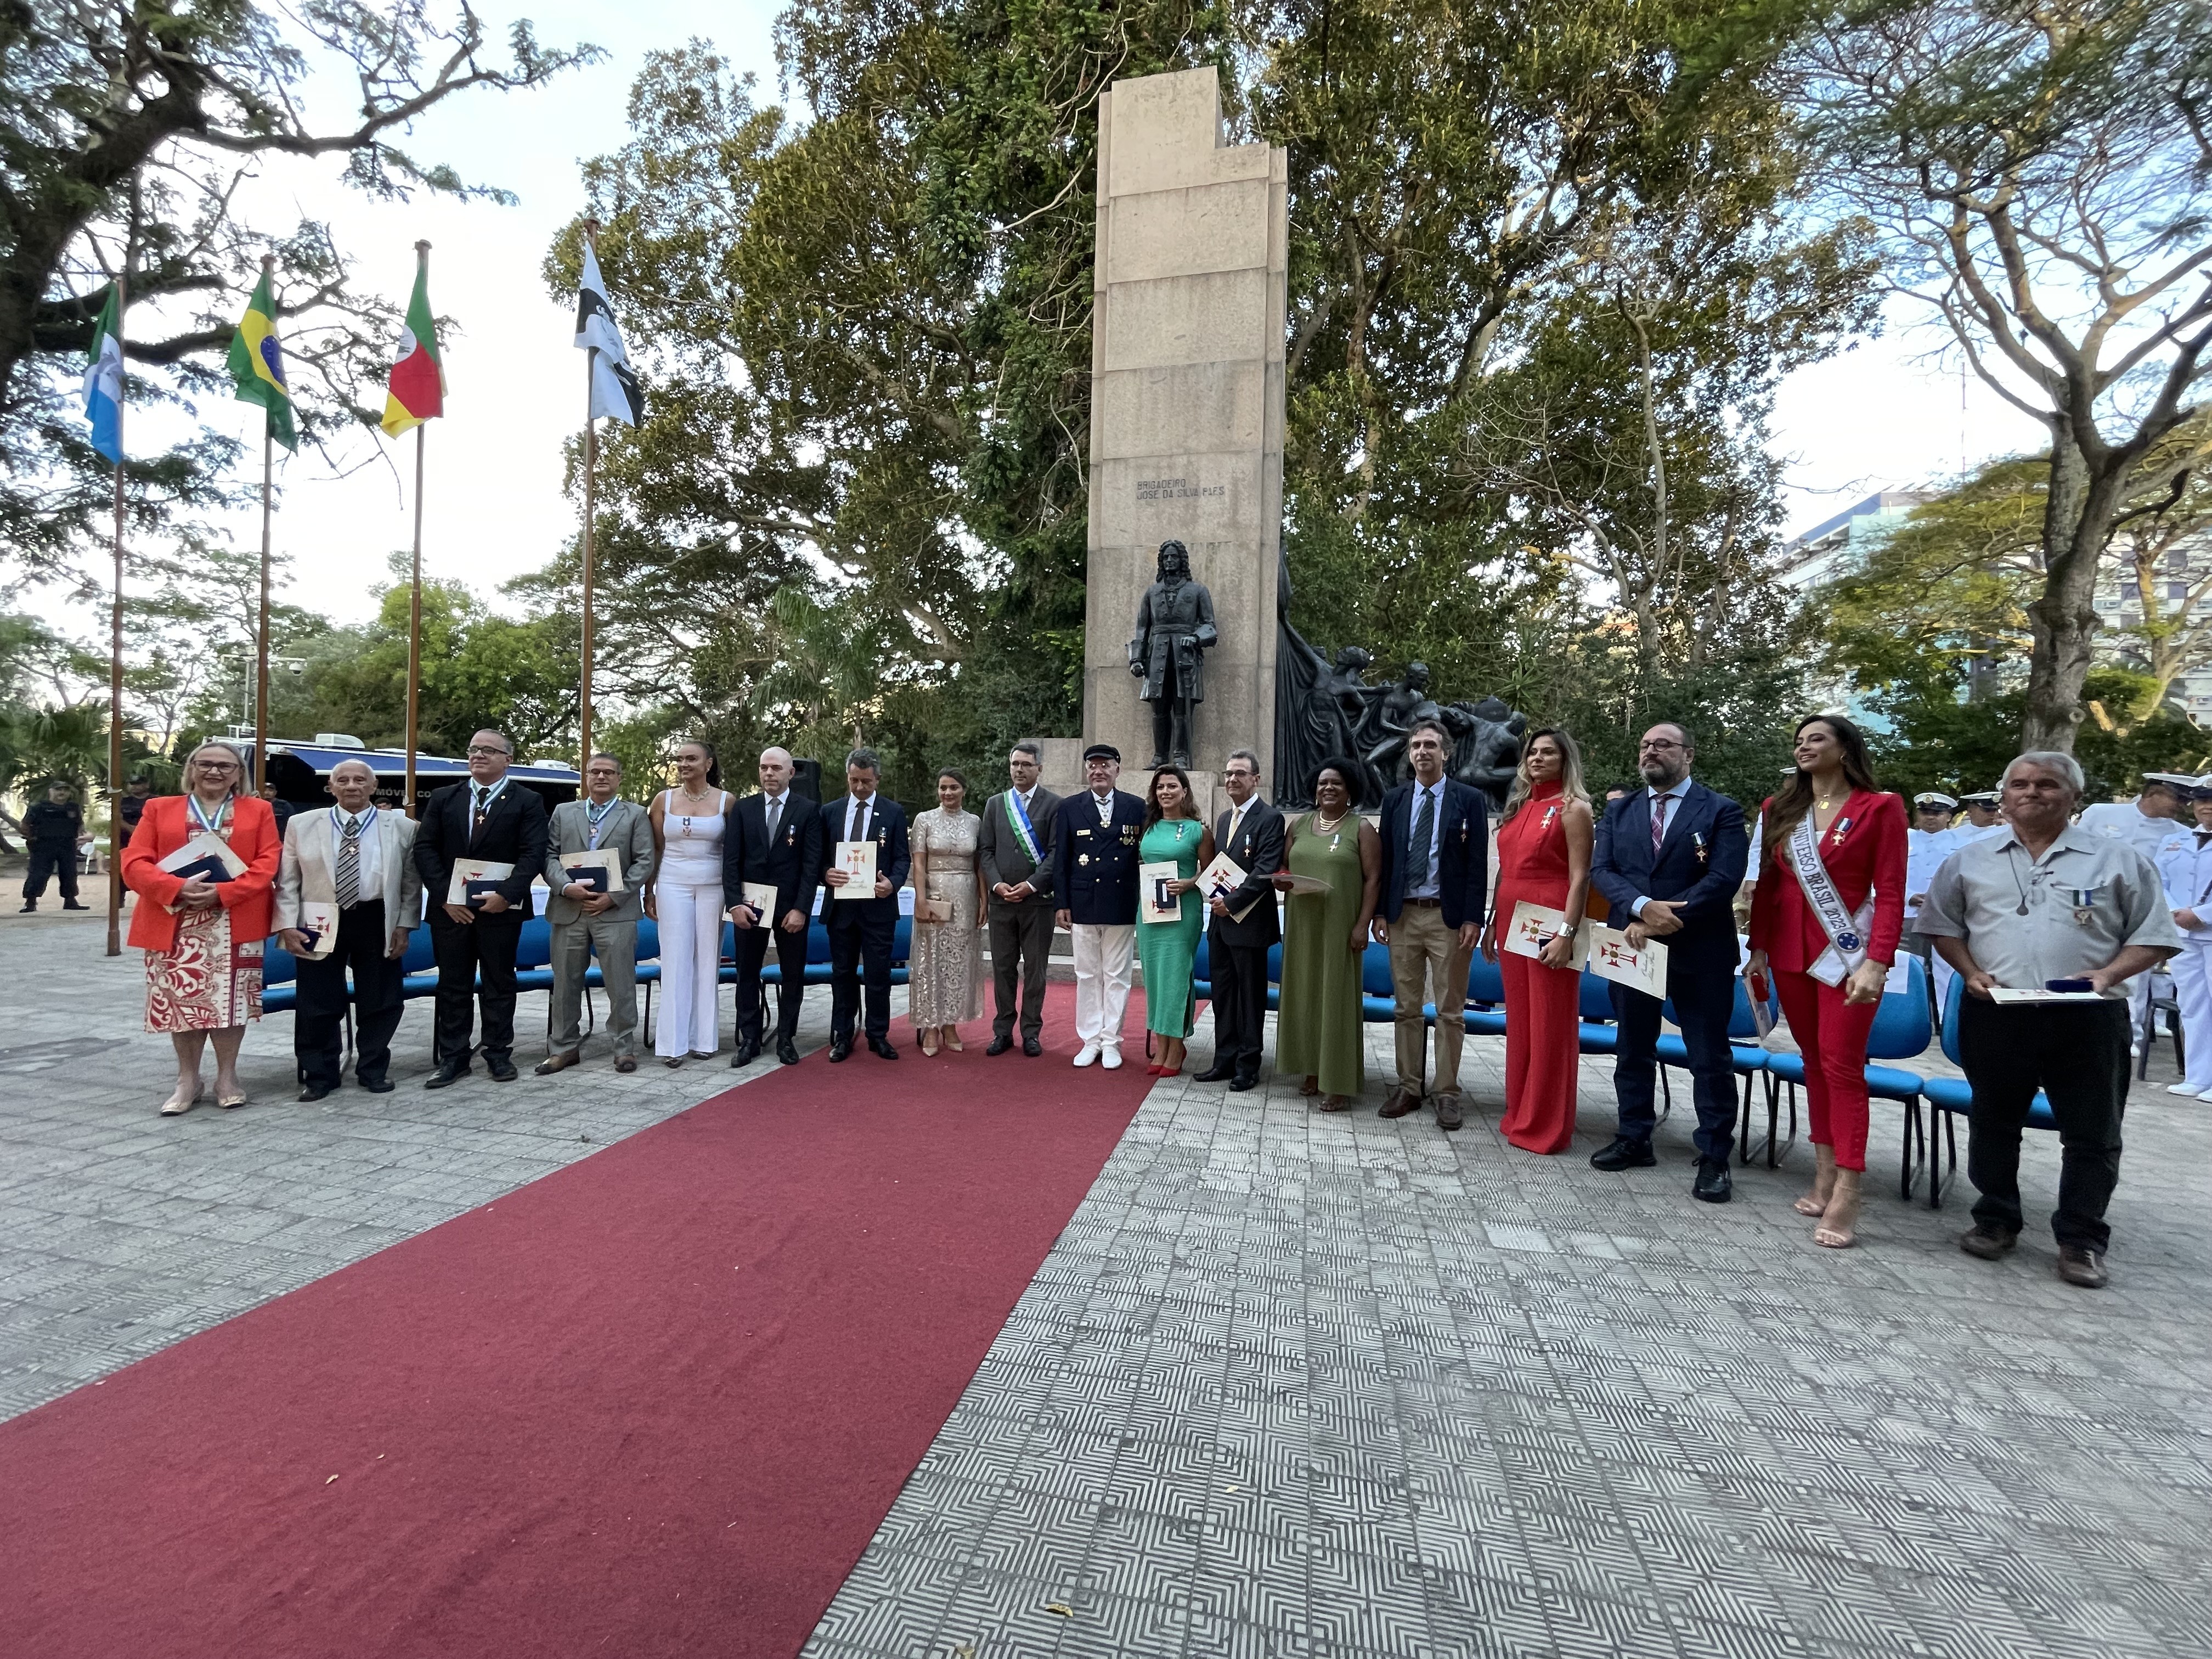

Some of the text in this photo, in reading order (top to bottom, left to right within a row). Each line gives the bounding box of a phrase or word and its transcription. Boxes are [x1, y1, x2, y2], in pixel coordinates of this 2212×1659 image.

[1137, 479, 1186, 490] BRIGADEIRO
[1163, 489, 1173, 498] DA
[1177, 487, 1199, 498] SILVA
[1202, 486, 1224, 496] PAES
[376, 787, 406, 797] MÓVE
[1793, 824, 1847, 930] UNIVERSO BRASIL 2023
